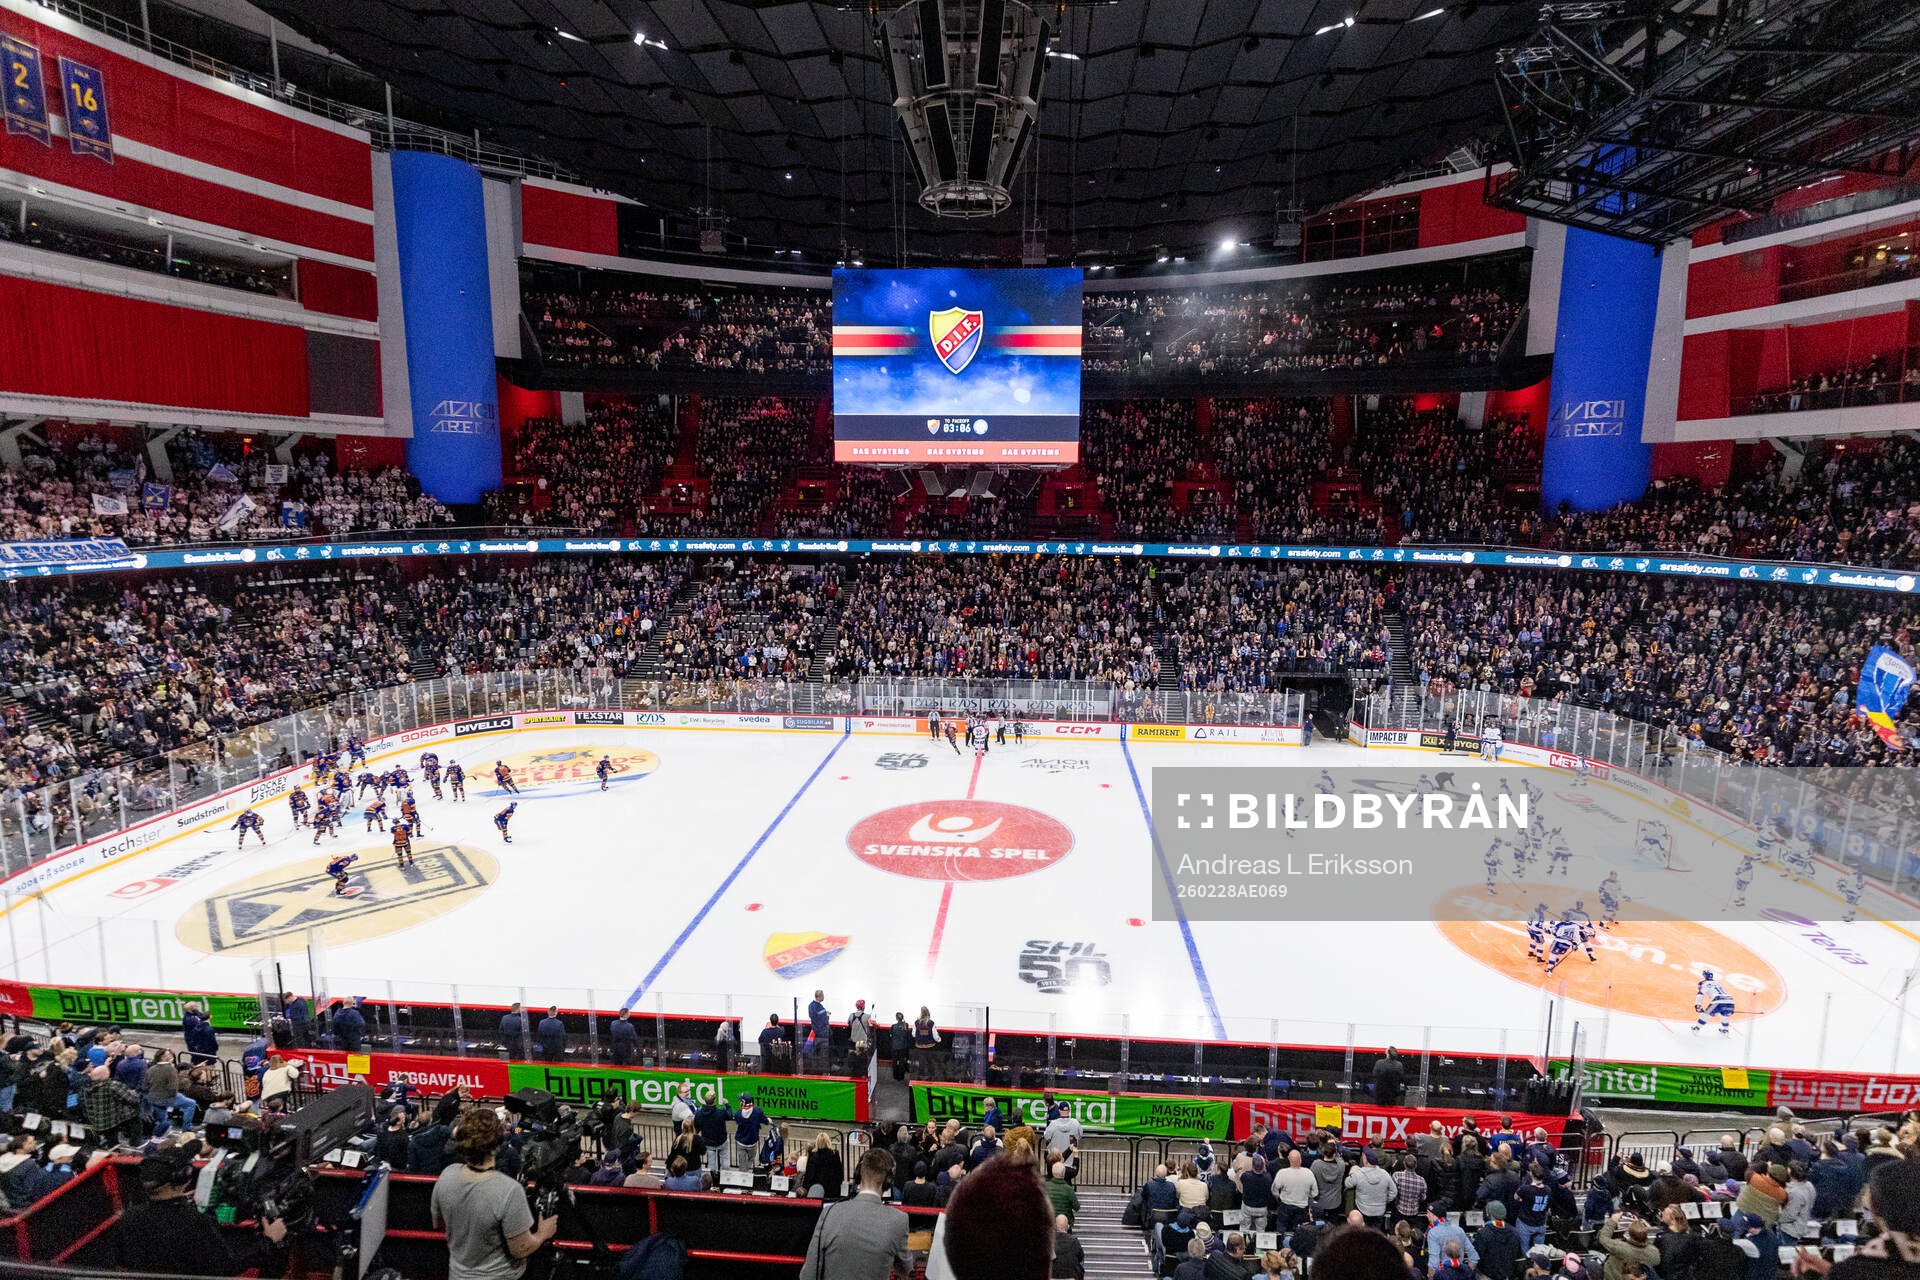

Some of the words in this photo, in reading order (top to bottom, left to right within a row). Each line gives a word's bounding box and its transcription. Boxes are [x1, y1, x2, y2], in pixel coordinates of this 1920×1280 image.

[12, 62, 29, 89] 2
[71, 83, 97, 111] 16
[576, 712, 623, 720] TEXSTAR
[636, 713, 666, 722] RYDS
[457, 718, 511, 735] DIVELLO
[1056, 726, 1101, 734] CCM
[1137, 728, 1180, 736] RAMIRENT
[1209, 728, 1237, 737] RAIL
[401, 727, 449, 743] BORGA
[1370, 732, 1397, 741] IMPACT
[1398, 733, 1408, 742] BY
[251, 775, 288, 803] HOCKEY
[1612, 774, 1648, 793] Sundström
[259, 786, 287, 801] STORE
[177, 804, 225, 828] Sundström
[101, 826, 162, 859] techster
[1849, 834, 1880, 864] 81
[863, 844, 981, 858] SVENSKA
[990, 847, 1051, 860] SPEL
[1021, 940, 1107, 957] SHL
[1801, 931, 1869, 965] Telia
[1018, 954, 1113, 987] 50
[58, 990, 209, 1021] byggrentl
[757, 1085, 807, 1098] MASKIN
[1679, 1084, 1755, 1099] UTHYRNING
[1152, 1103, 1205, 1118] MASKIN
[1139, 1115, 1215, 1131] UTHYRNING
[1250, 1103, 1410, 1140] bygbox
